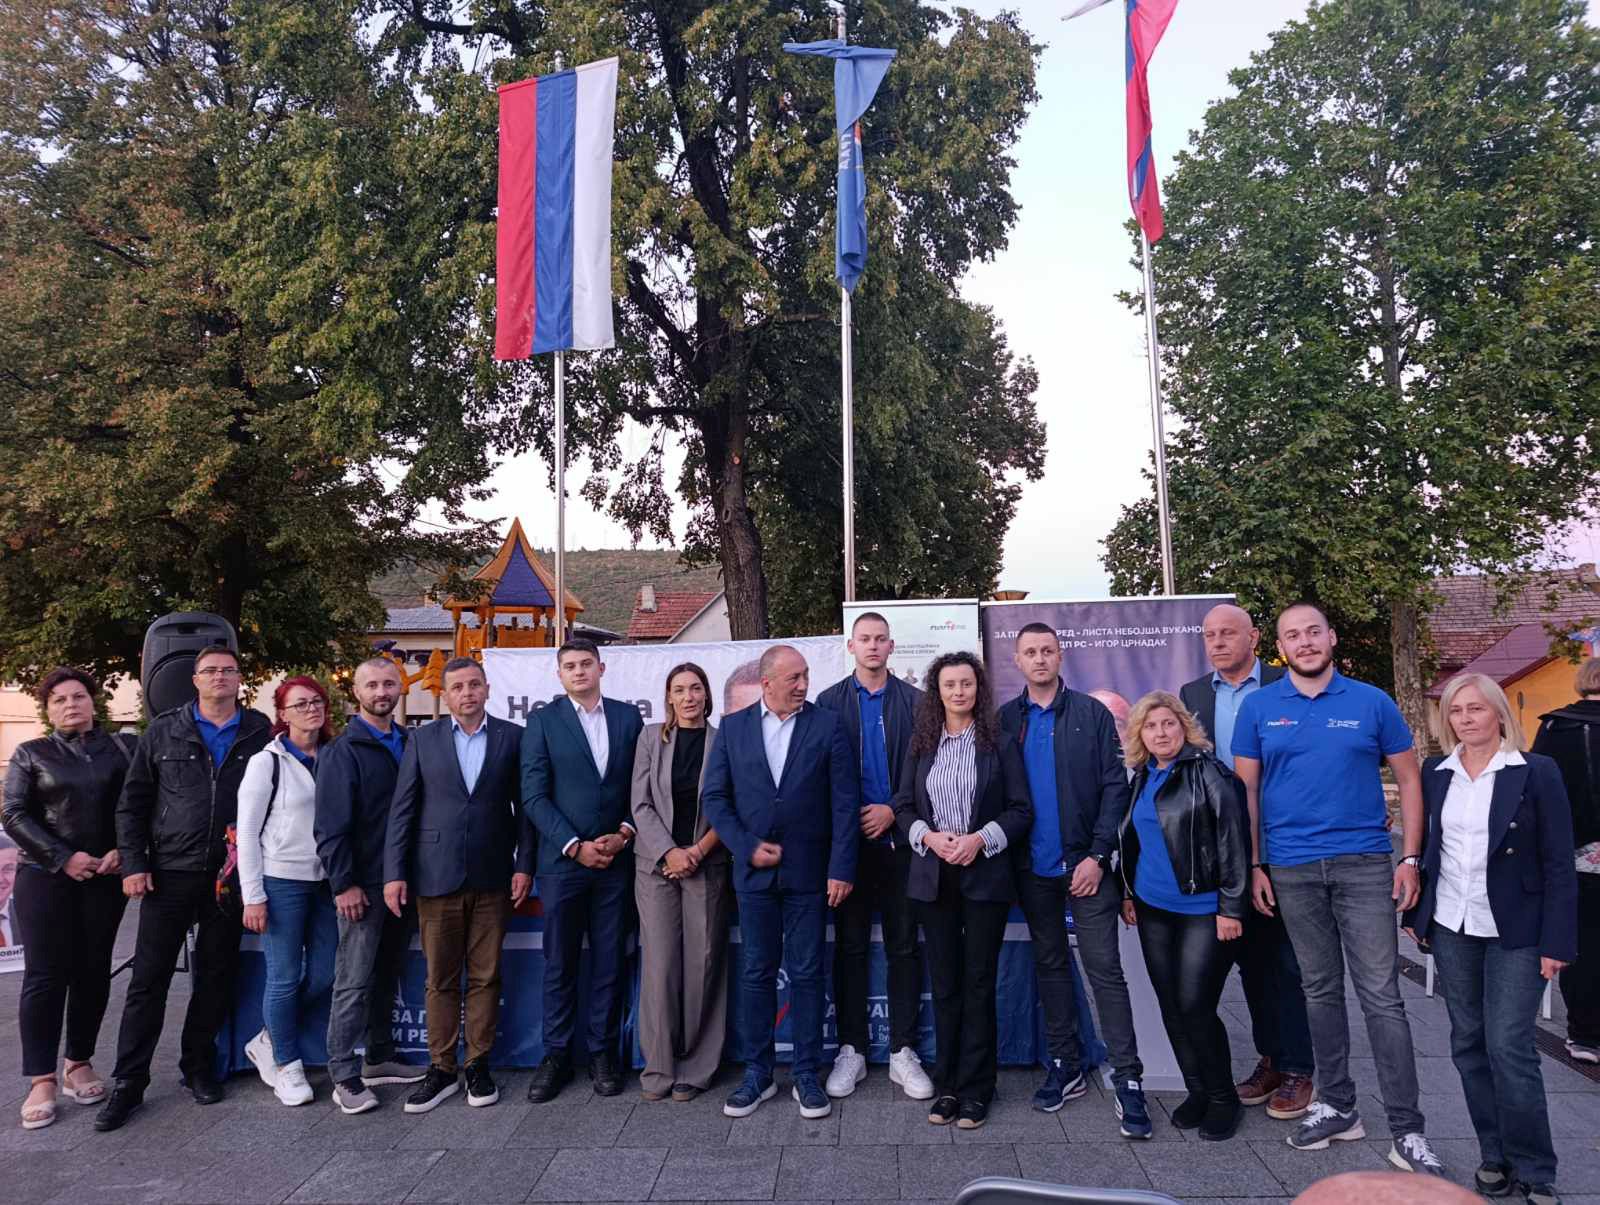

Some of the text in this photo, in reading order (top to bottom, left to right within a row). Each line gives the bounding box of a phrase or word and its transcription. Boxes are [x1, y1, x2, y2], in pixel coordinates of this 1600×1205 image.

[994, 630, 1006, 639] ЗА
[1082, 627, 1113, 637] ЛИСТА
[1114, 626, 1161, 636] НЕБОЈША
[1162, 625, 1205, 634] ВУКАНО
[1058, 640, 1073, 649] ДП
[1074, 640, 1087, 648] РС
[1094, 639, 1119, 648] ИГОР
[1121, 638, 1168, 648] ЦРНАДАК
[391, 1008, 413, 1024] ЗА
[407, 1028, 429, 1043] РЕ
